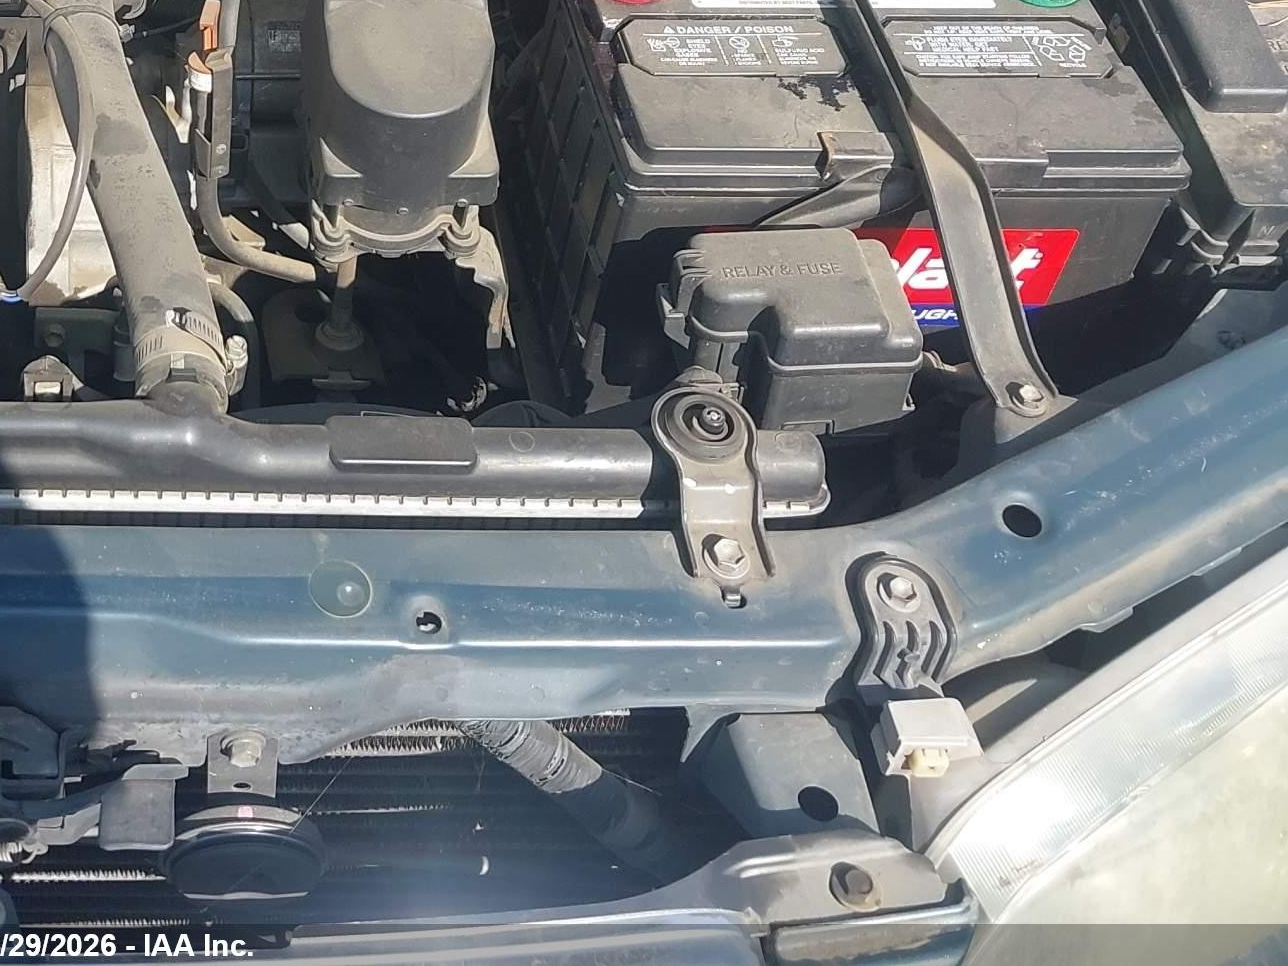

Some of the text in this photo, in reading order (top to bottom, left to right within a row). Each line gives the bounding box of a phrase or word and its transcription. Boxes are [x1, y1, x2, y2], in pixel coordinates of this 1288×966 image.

[676, 26, 731, 34] DANGER
[722, 262, 843, 278] RELAY & FUSE
